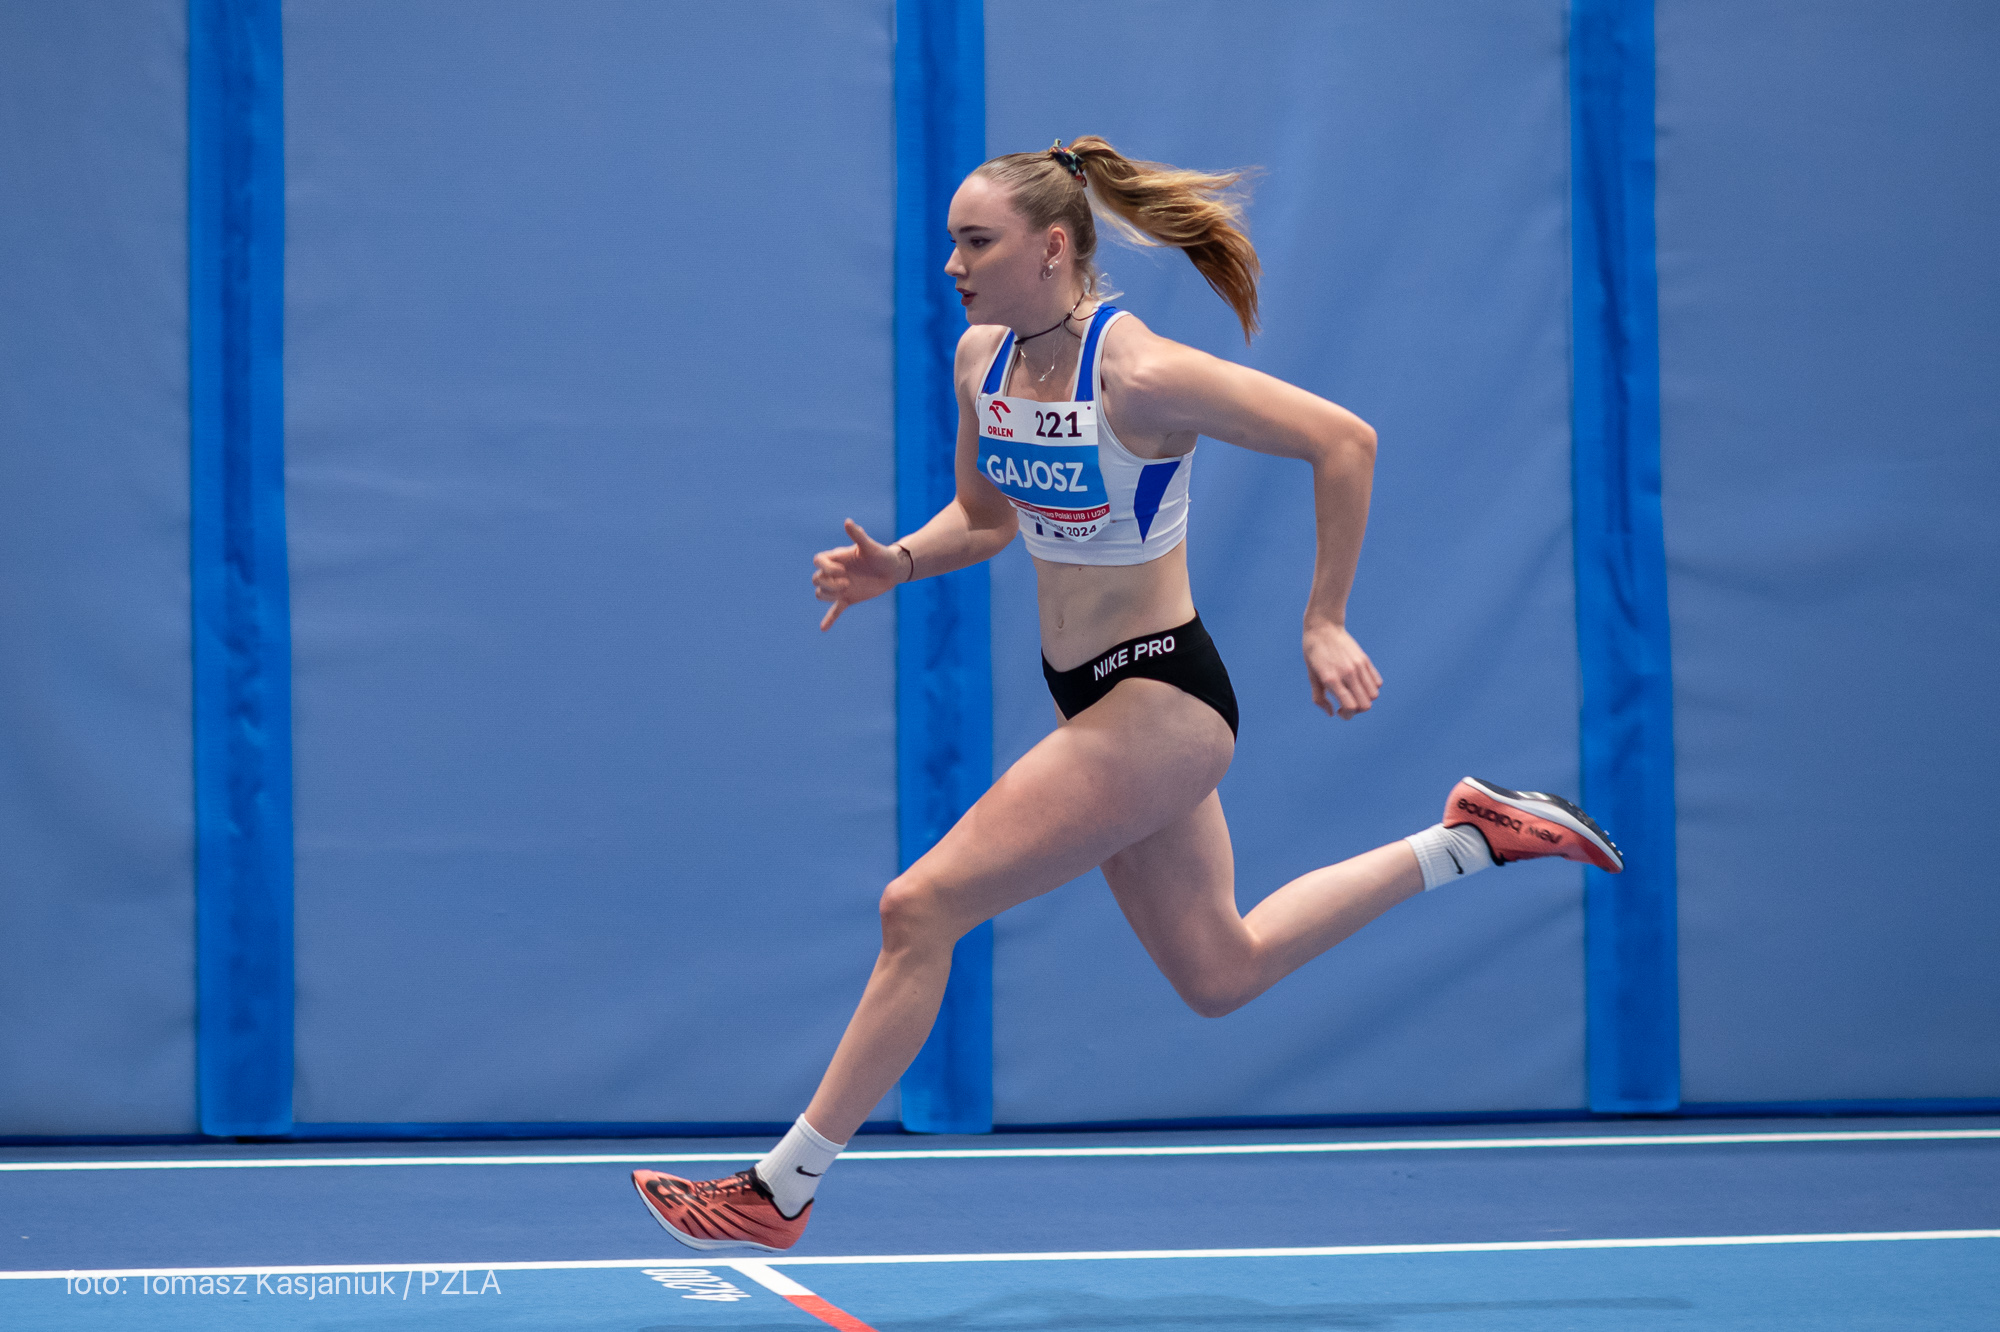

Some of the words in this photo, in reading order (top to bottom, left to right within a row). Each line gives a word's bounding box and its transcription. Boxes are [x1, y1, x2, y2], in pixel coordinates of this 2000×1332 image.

[987, 425, 1013, 438] ORLEN
[1035, 410, 1082, 438] 221
[986, 454, 1088, 493] GAJOSZ
[1055, 511, 1072, 520] Polski
[1090, 508, 1107, 518] U20
[1066, 524, 1097, 537] 2024
[1093, 648, 1129, 681] NIKE
[1134, 635, 1175, 661] PRO
[1457, 798, 1523, 834] balance
